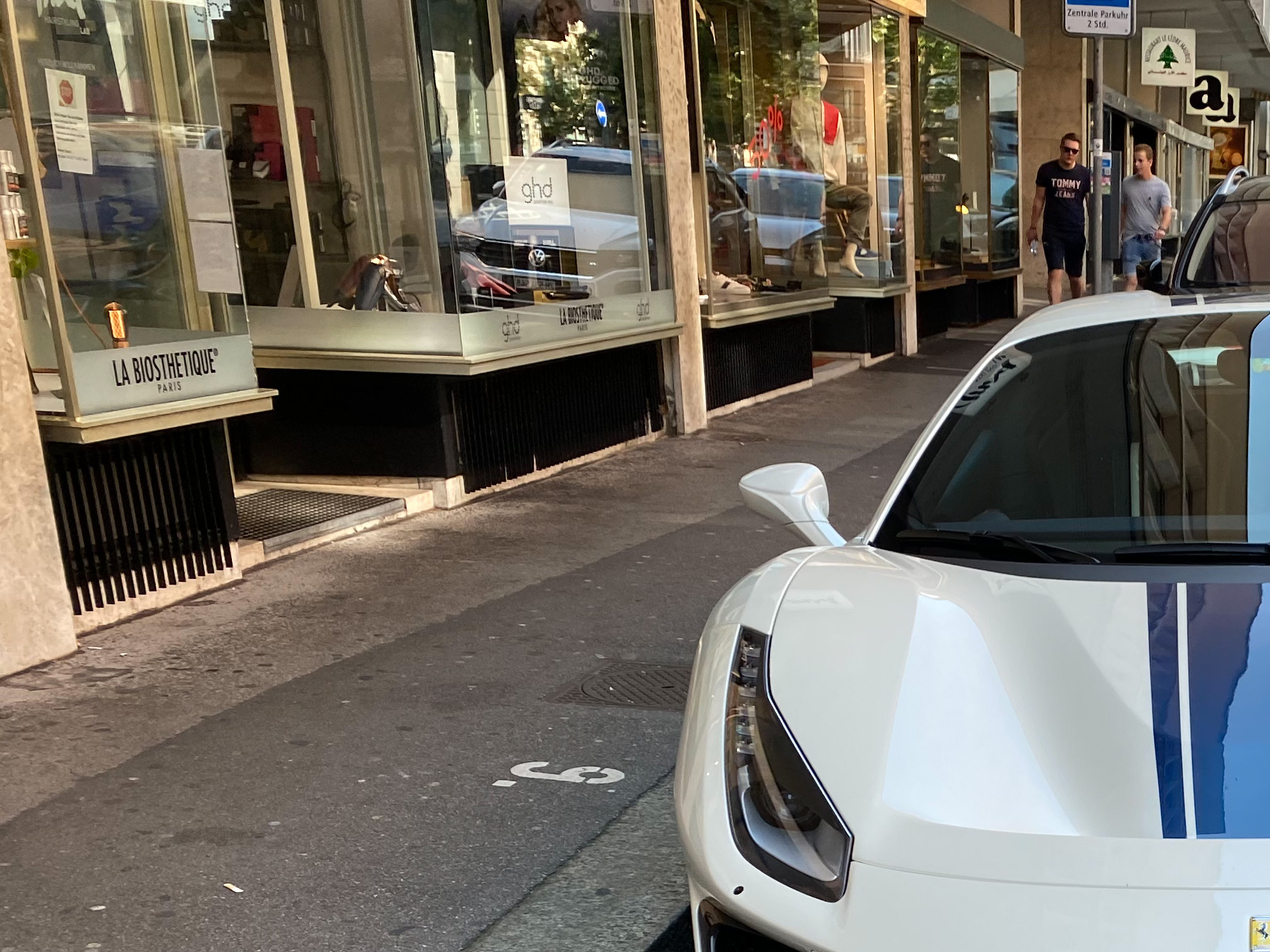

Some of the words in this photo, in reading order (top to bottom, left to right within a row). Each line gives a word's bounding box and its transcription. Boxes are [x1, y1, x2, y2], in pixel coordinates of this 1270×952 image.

[1067, 8, 1098, 18] Zentrale
[1100, 10, 1129, 19] Parkuhr
[1087, 20, 1092, 28] 2
[1094, 20, 1109, 29] Std.
[1189, 74, 1225, 111] a
[521, 176, 553, 204] ghd
[1051, 177, 1082, 190] TOMMY
[112, 359, 130, 387] LA
[157, 381, 182, 393] PARIS
